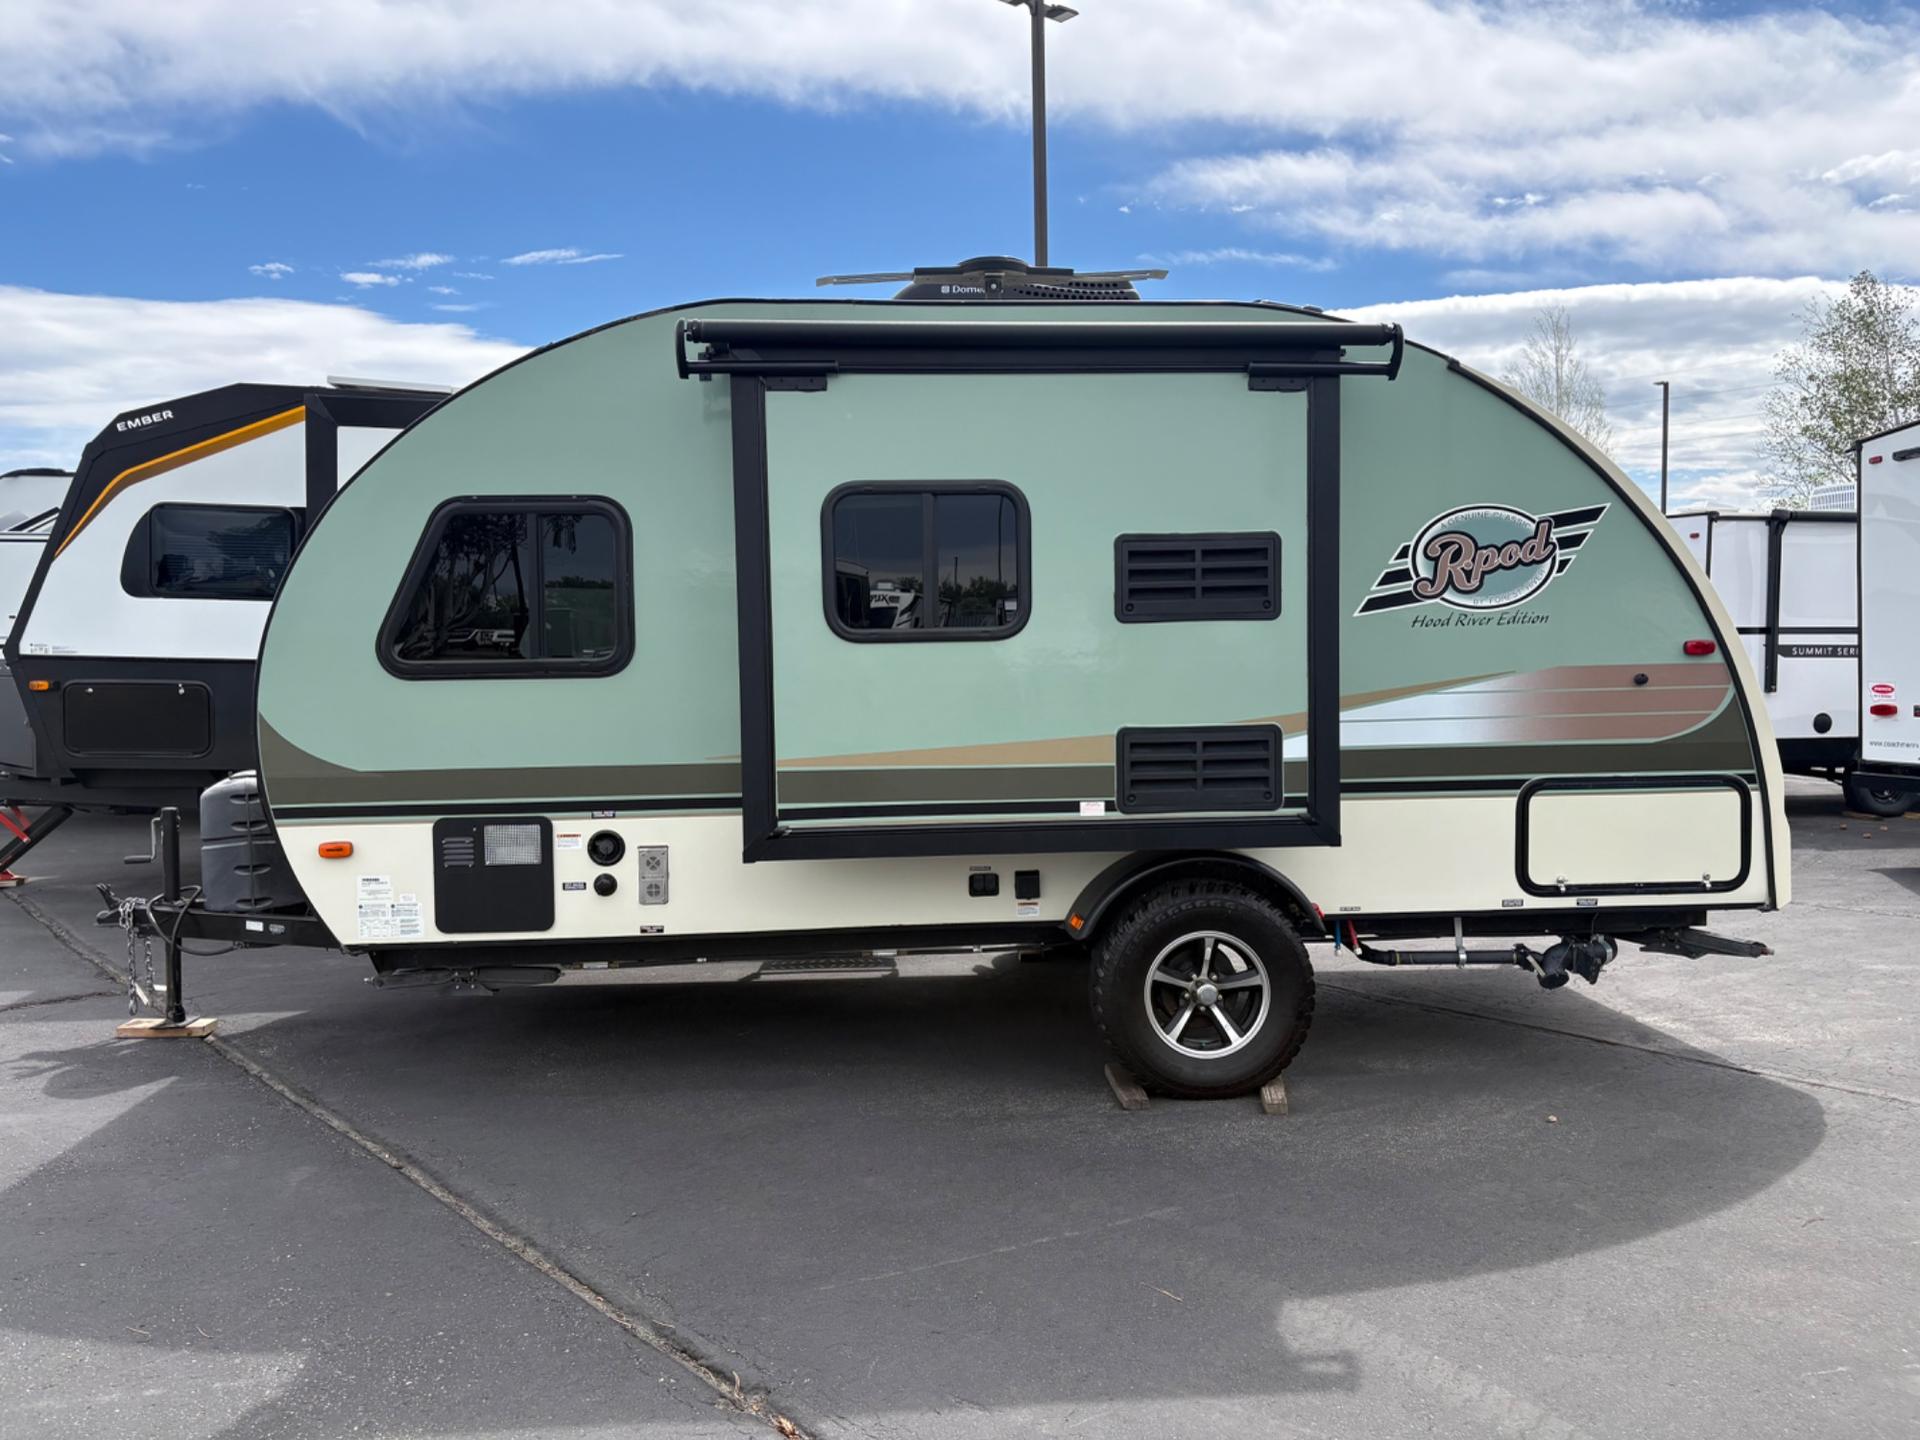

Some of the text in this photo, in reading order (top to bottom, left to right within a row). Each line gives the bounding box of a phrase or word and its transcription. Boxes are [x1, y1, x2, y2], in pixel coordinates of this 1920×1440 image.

[116, 410, 174, 432] EMBER
[1447, 511, 1488, 526] GENUINE
[1411, 609, 1550, 628] Hood River Edition
[1792, 647, 1833, 656] SUMMIT
